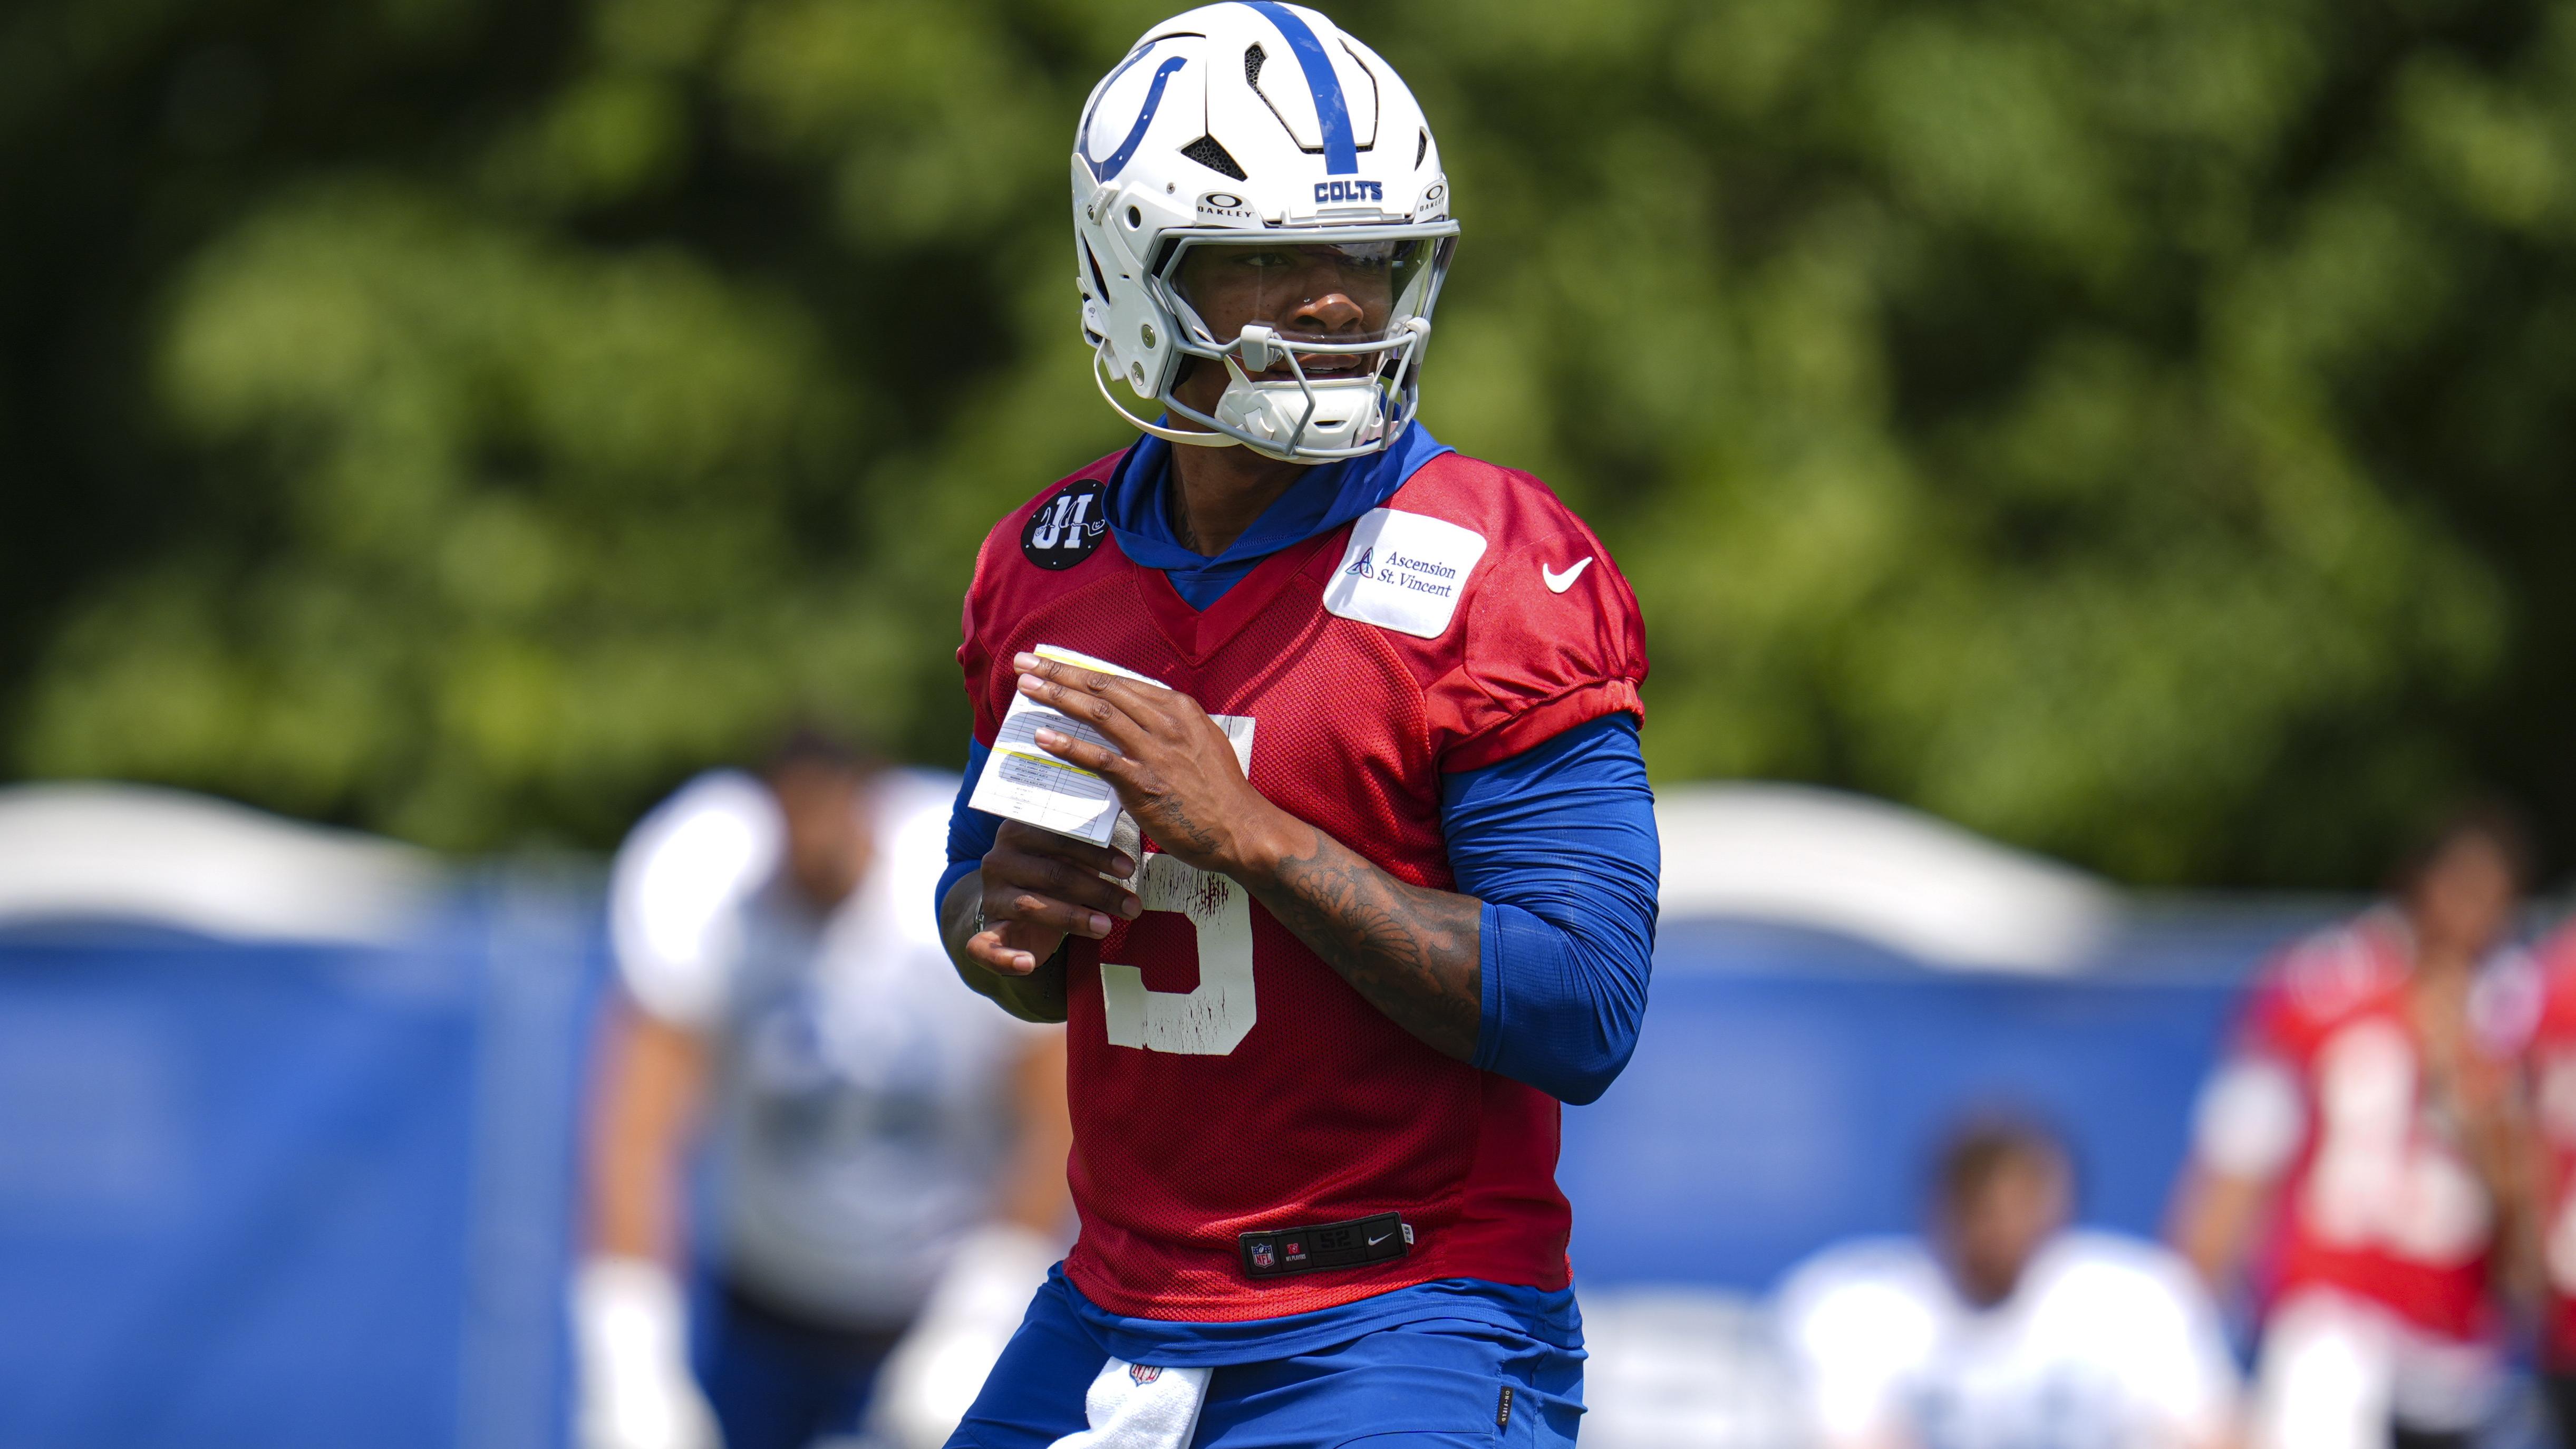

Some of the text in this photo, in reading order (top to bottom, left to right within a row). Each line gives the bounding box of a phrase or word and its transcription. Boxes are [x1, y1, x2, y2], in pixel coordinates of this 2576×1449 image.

[1314, 181, 1383, 202] COLTS
[1197, 206, 1252, 218] OAKLEY
[1420, 196, 1444, 211] OAKLEY
[1386, 552, 1456, 579] Ascension
[1377, 568, 1452, 598] St. Vincent
